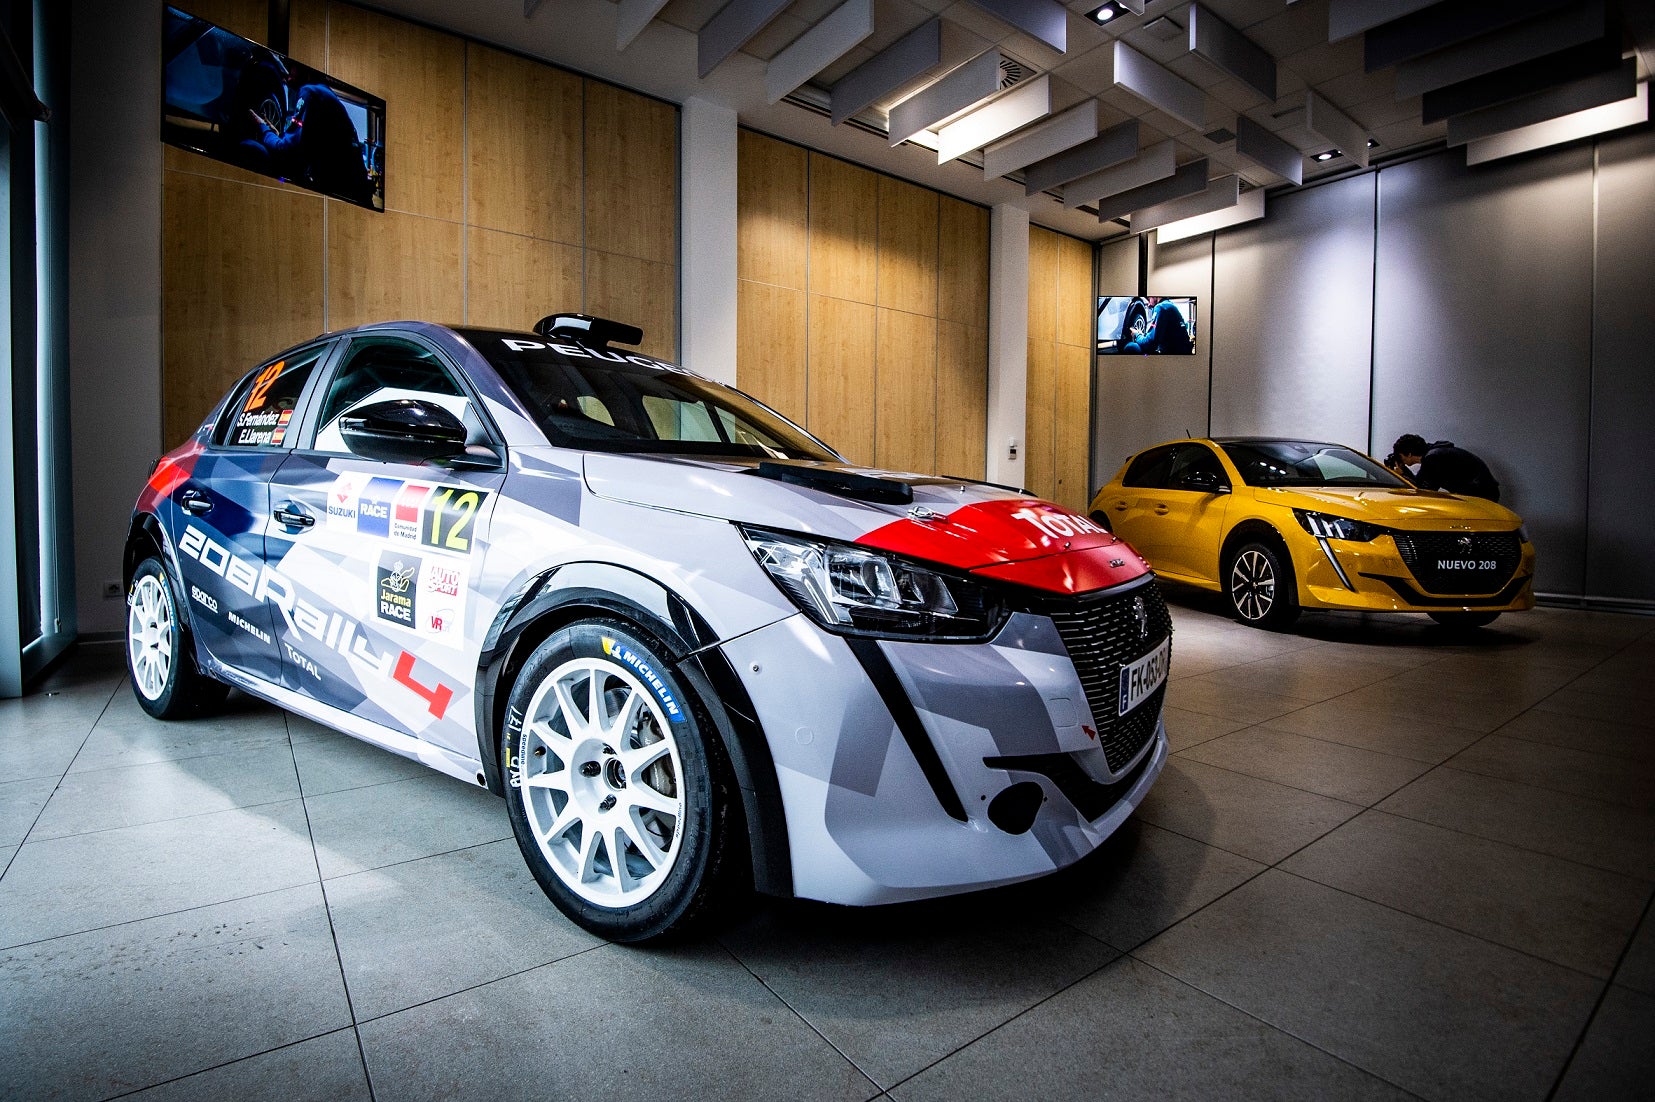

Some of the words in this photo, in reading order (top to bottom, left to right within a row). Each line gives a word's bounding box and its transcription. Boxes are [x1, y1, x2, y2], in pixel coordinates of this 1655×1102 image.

[244, 361, 285, 412] 12
[328, 507, 356, 518] SUZUKI
[360, 503, 388, 518] RACE
[431, 489, 479, 550] 12
[1011, 508, 1108, 539] TOTAL
[401, 531, 417, 540] Madrid
[1437, 560, 1476, 570] NUEVO
[1478, 560, 1497, 570] 208
[191, 586, 218, 611] sparco
[381, 589, 411, 607] Jarama
[381, 601, 411, 621] RACE
[228, 611, 271, 644] MICHELIN
[285, 643, 321, 681] TOTAL
[622, 651, 680, 715] MICHELIN
[1122, 694, 1127, 710] F
